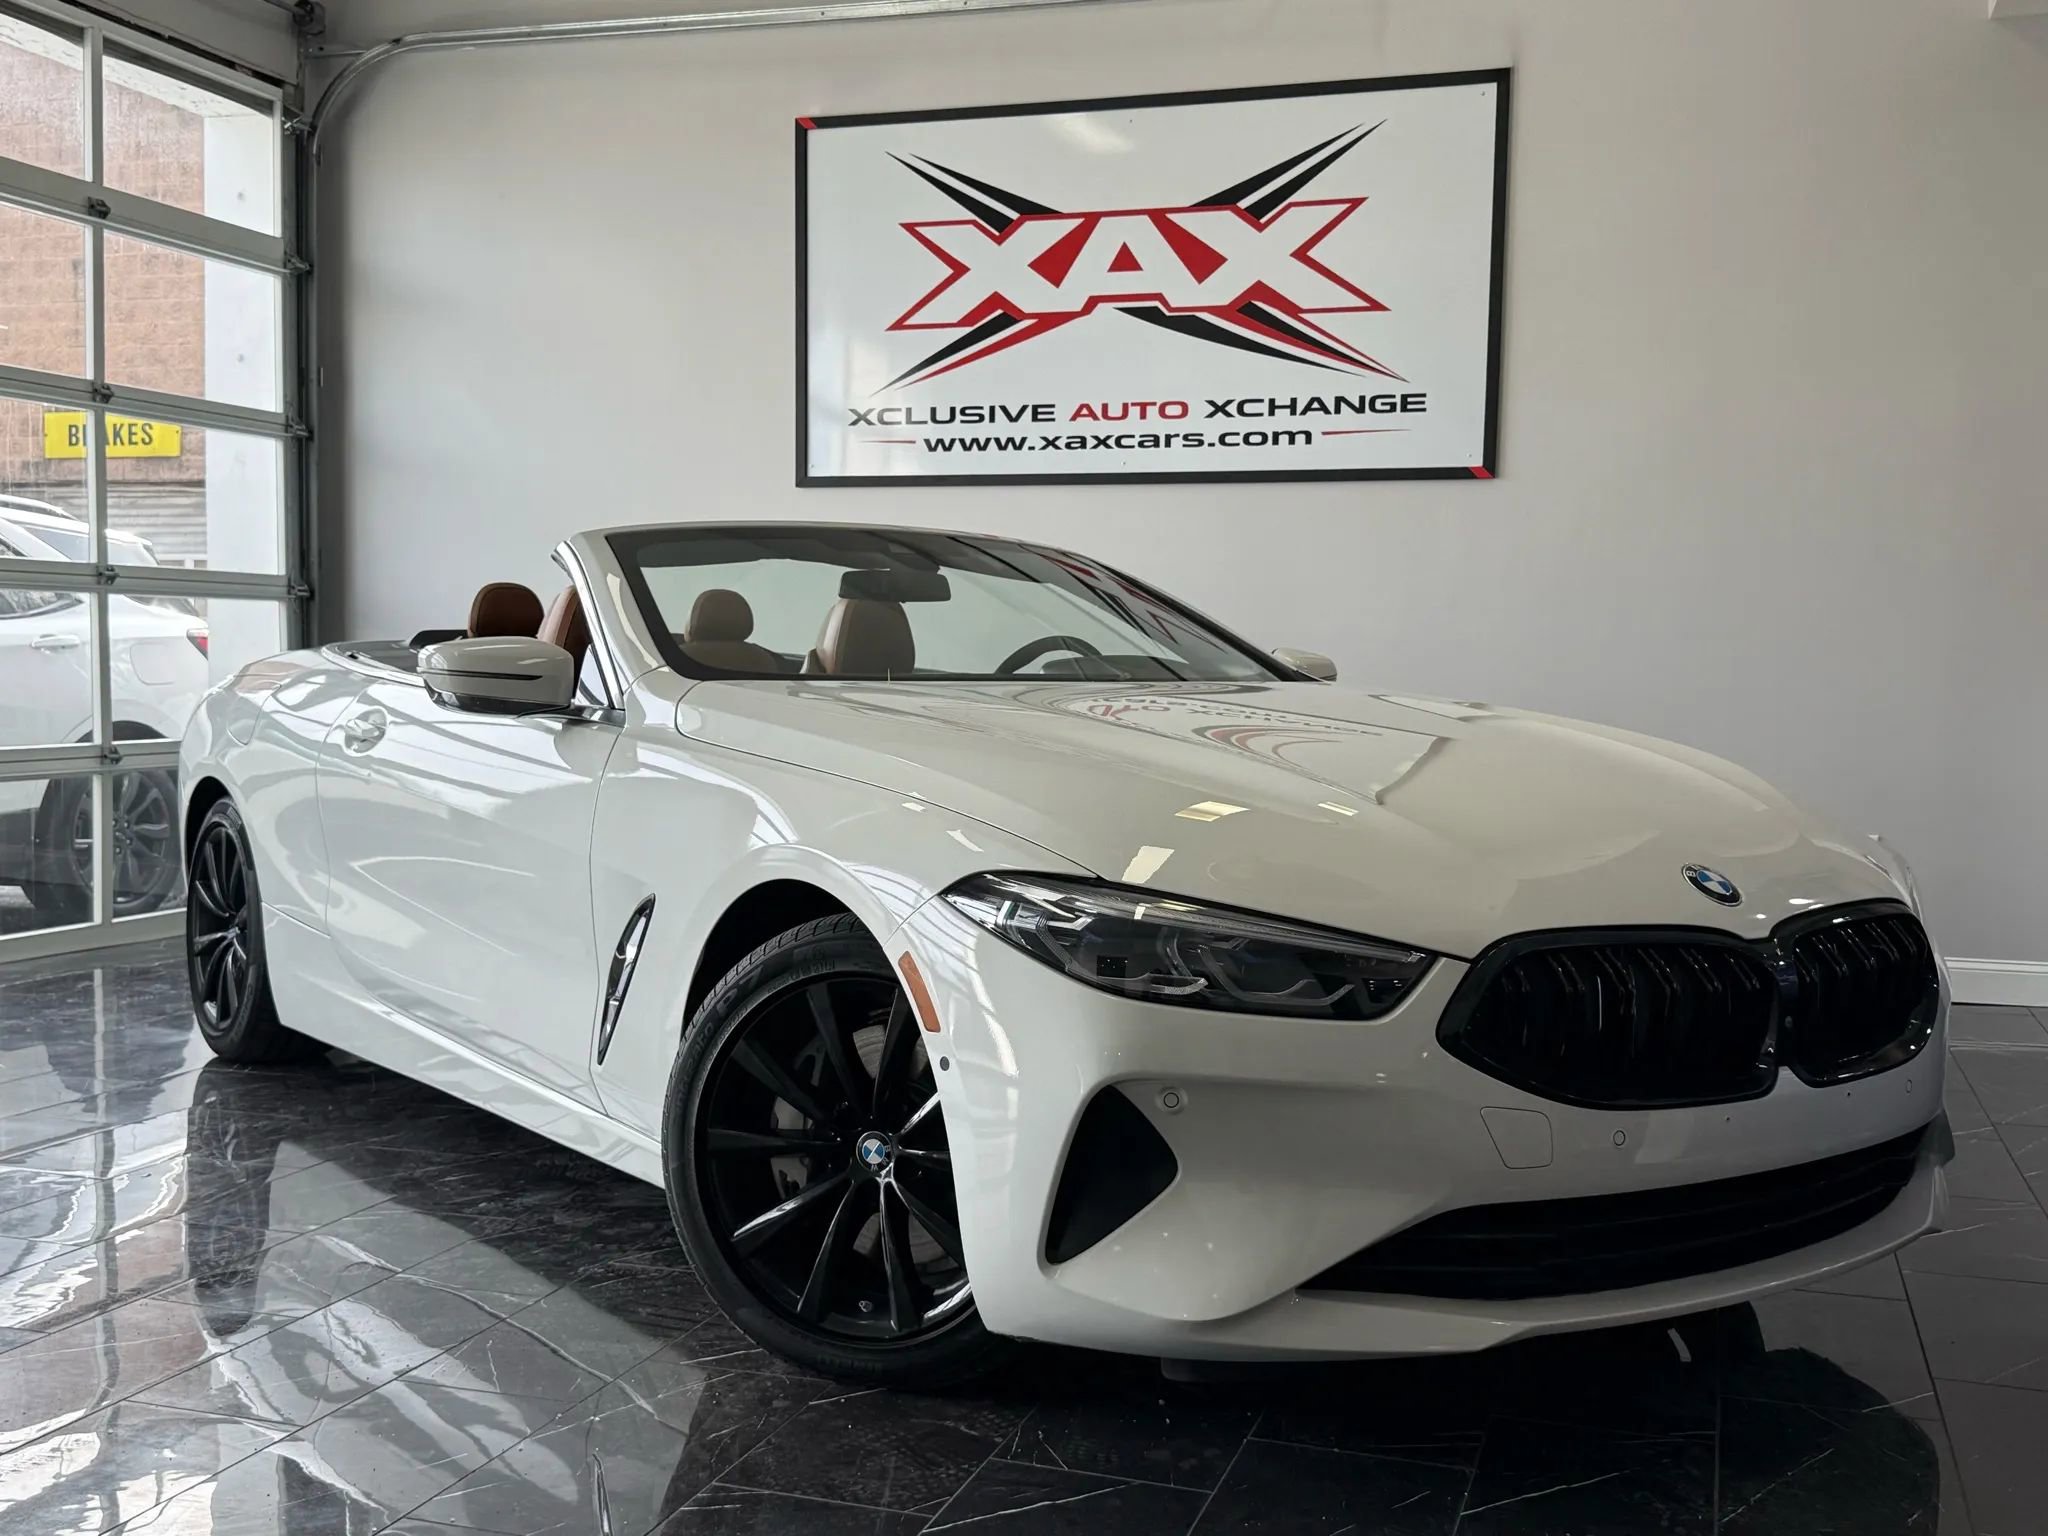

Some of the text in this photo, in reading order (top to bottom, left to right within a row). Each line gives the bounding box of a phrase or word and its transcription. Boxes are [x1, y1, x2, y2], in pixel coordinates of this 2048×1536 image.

[886, 197, 1391, 332] XAX
[848, 393, 1427, 426] XCLUSIVE AUTO XCHANGE
[68, 422, 154, 447] BKES
[923, 429, 1313, 453] www.xaxcars.com
